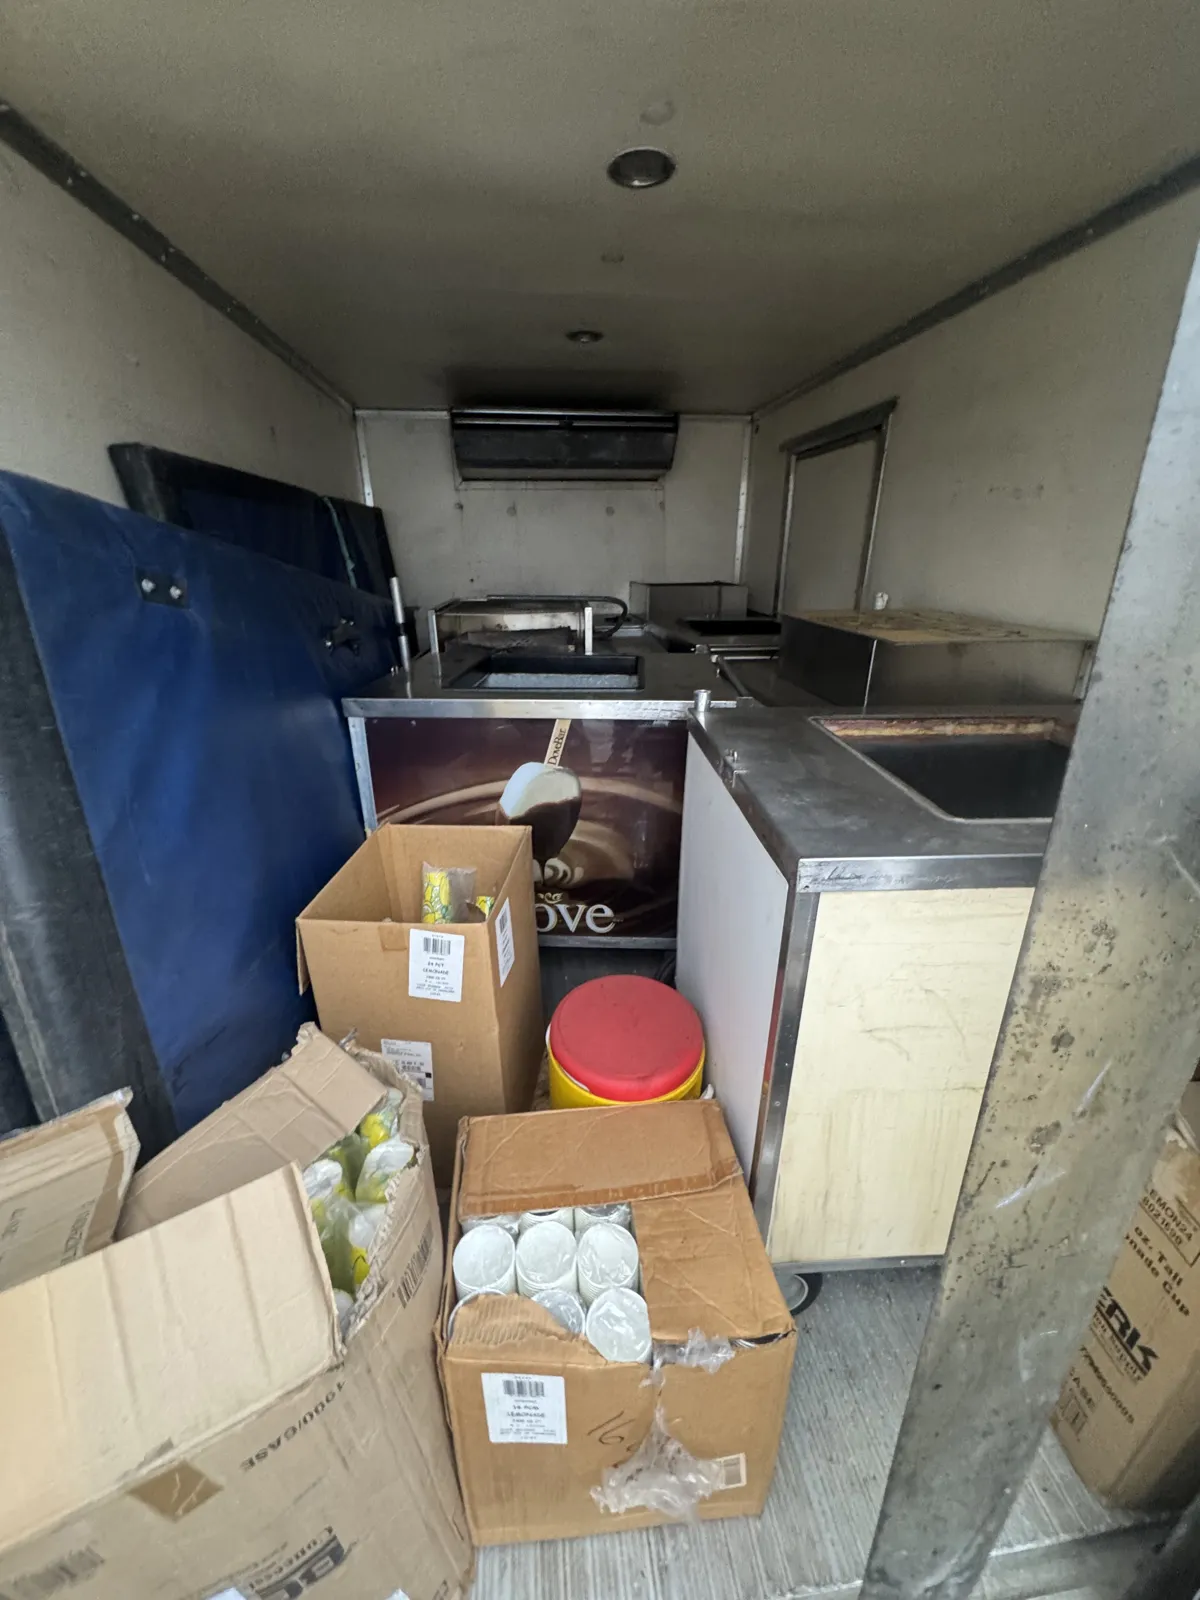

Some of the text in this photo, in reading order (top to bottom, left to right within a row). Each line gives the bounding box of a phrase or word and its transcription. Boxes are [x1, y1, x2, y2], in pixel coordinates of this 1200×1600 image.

[535, 903, 616, 933] ove
[1158, 1251, 1183, 1287] Tall
[1162, 1281, 1190, 1317] Cup
